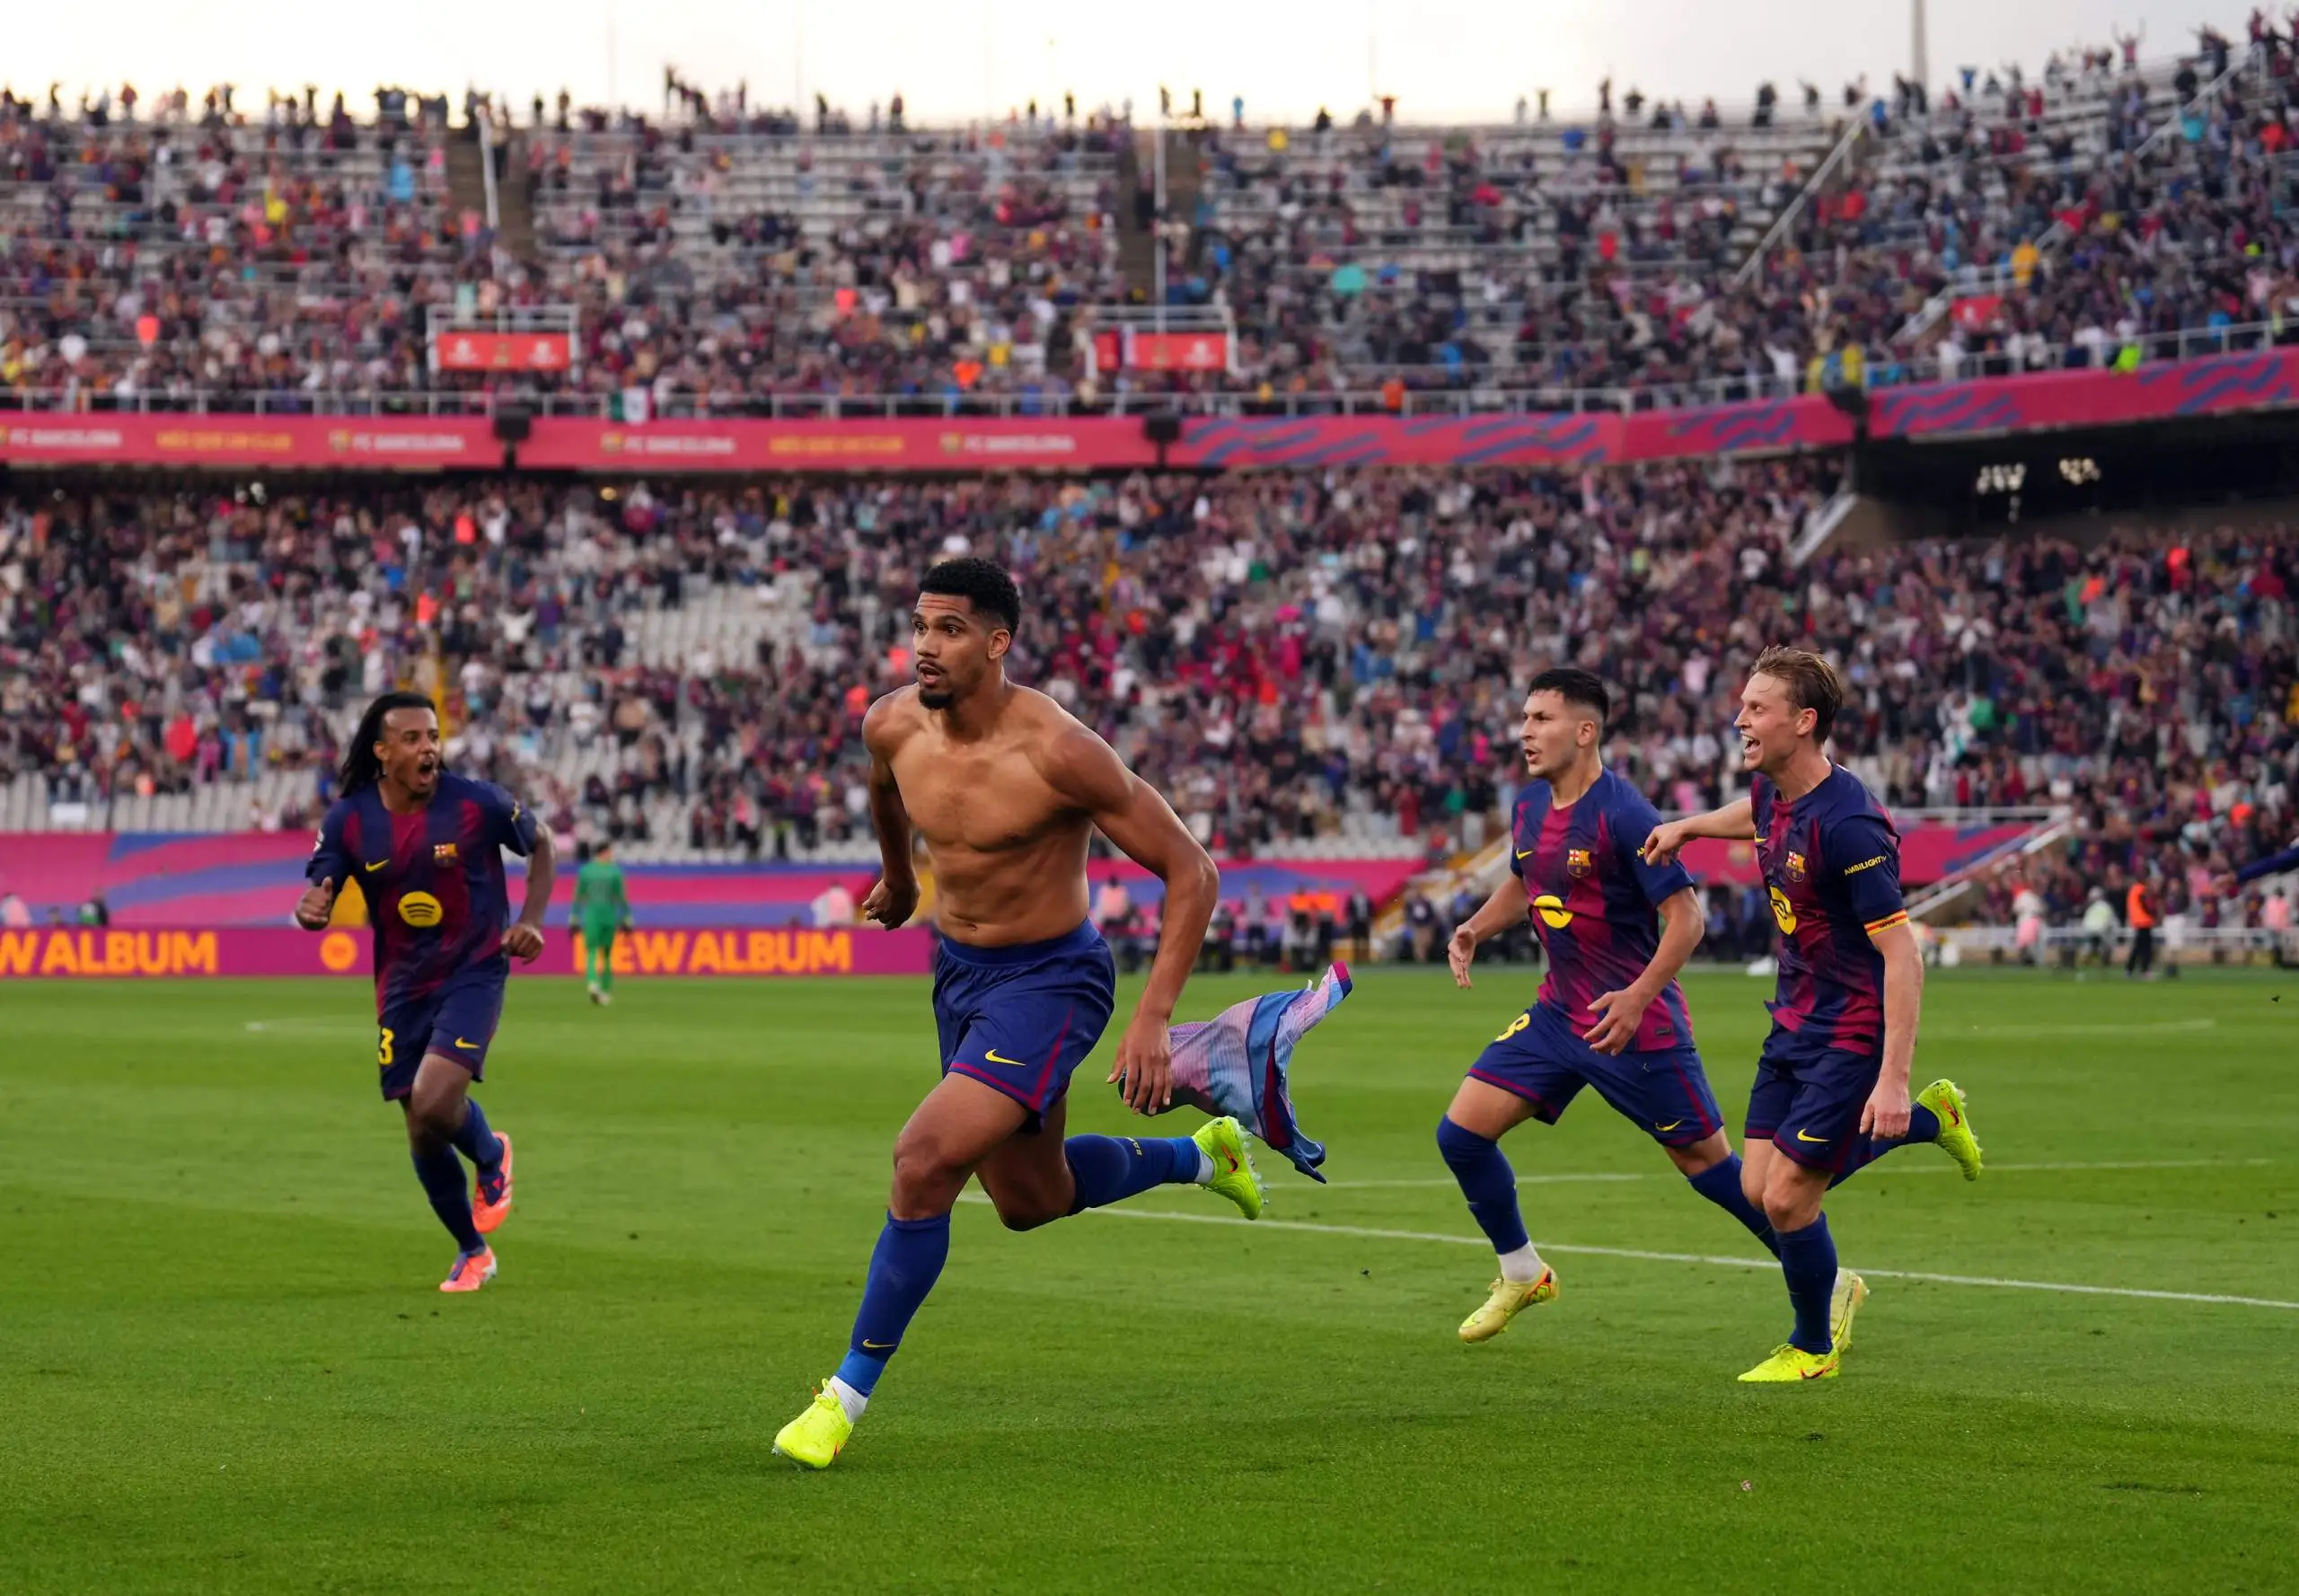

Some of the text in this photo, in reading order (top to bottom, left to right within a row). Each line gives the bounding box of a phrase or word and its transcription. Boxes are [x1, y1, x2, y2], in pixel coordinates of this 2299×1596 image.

[41, 930, 218, 974] ALBUM
[688, 930, 852, 974] ALBUM
[378, 1027, 394, 1065] 3
